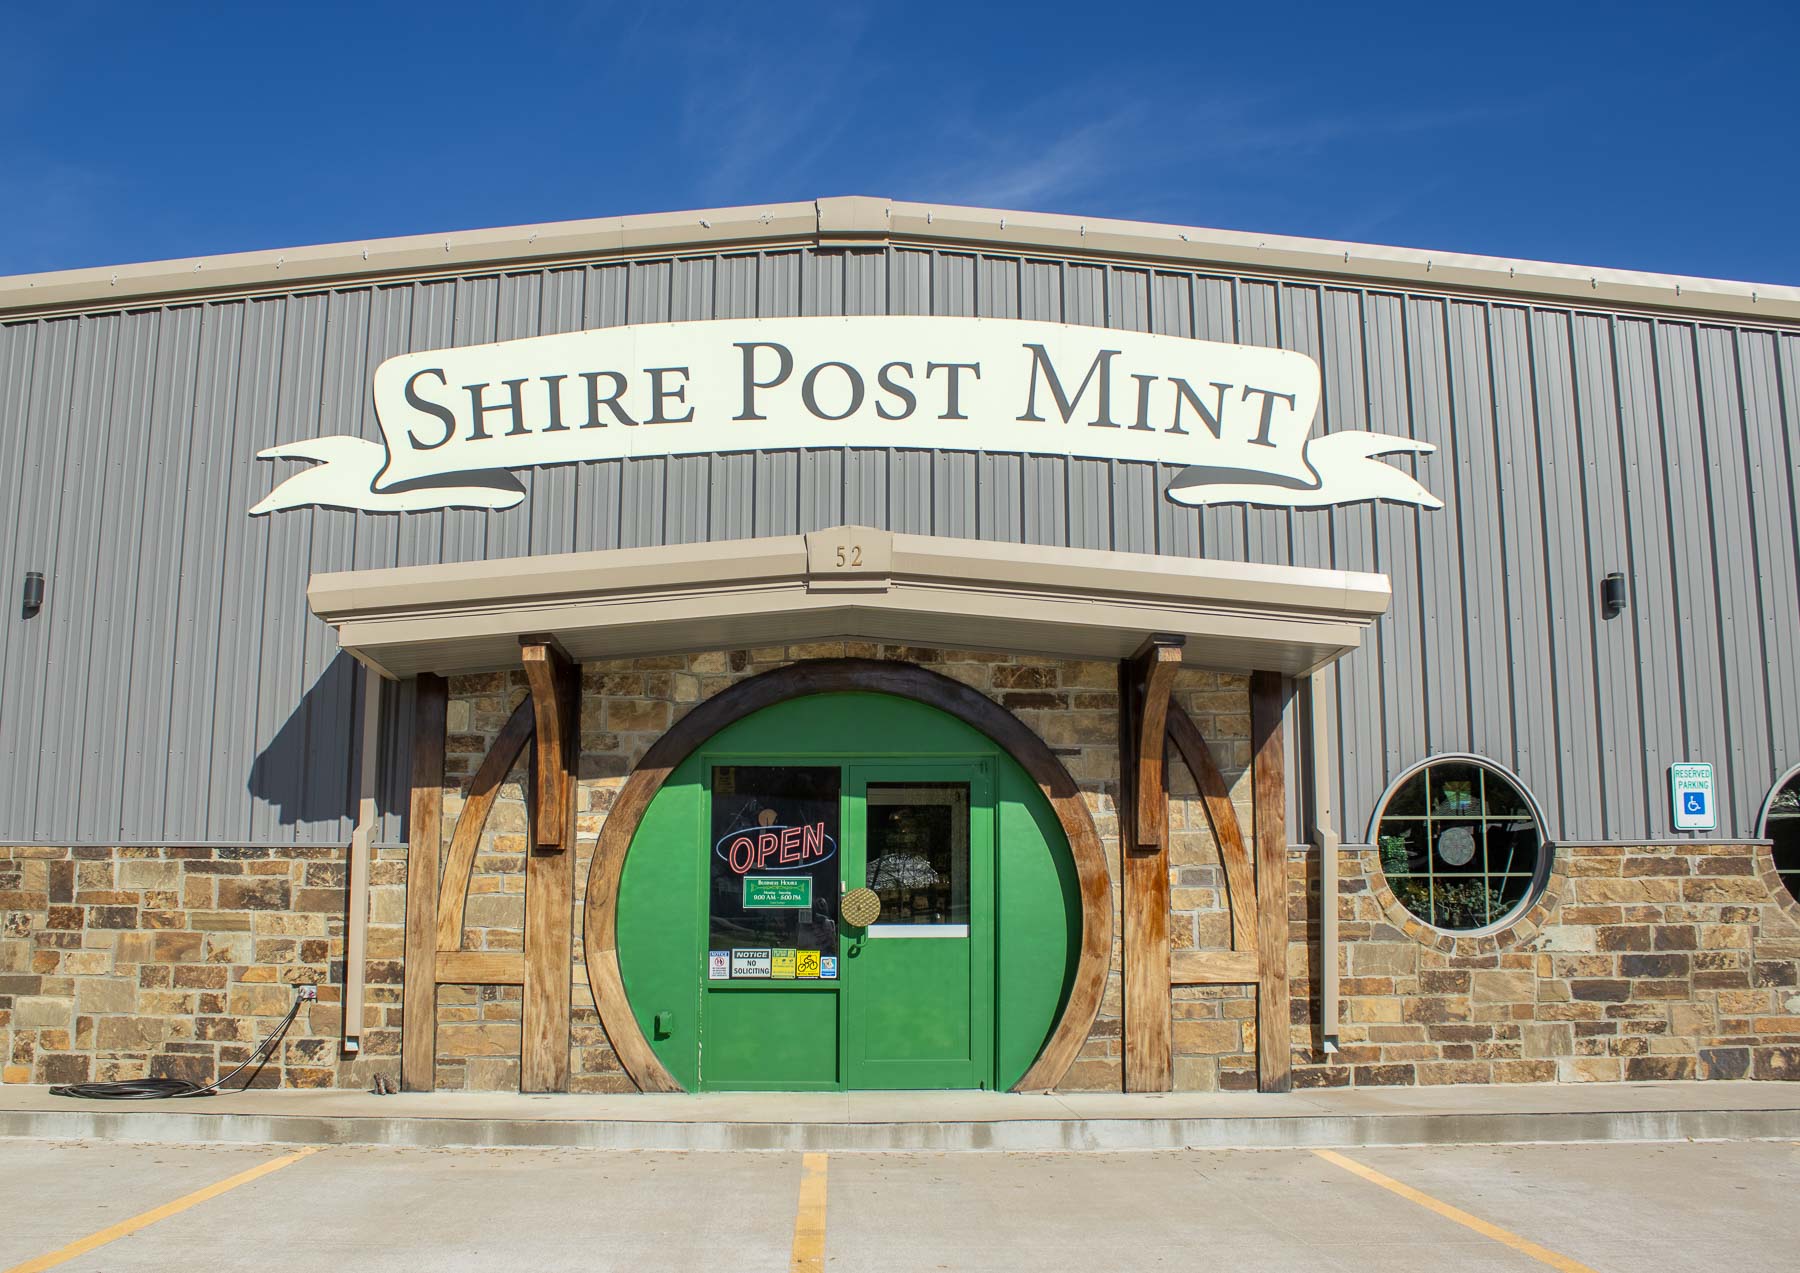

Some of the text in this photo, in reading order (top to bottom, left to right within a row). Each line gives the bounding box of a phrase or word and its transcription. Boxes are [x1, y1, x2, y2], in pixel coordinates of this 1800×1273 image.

[403, 341, 1296, 451] SHIRE POST MINT
[836, 545, 863, 568] 52
[1675, 769, 1710, 778] RESERVED
[1678, 780, 1710, 789] PARKING
[729, 822, 824, 874] OPEN
